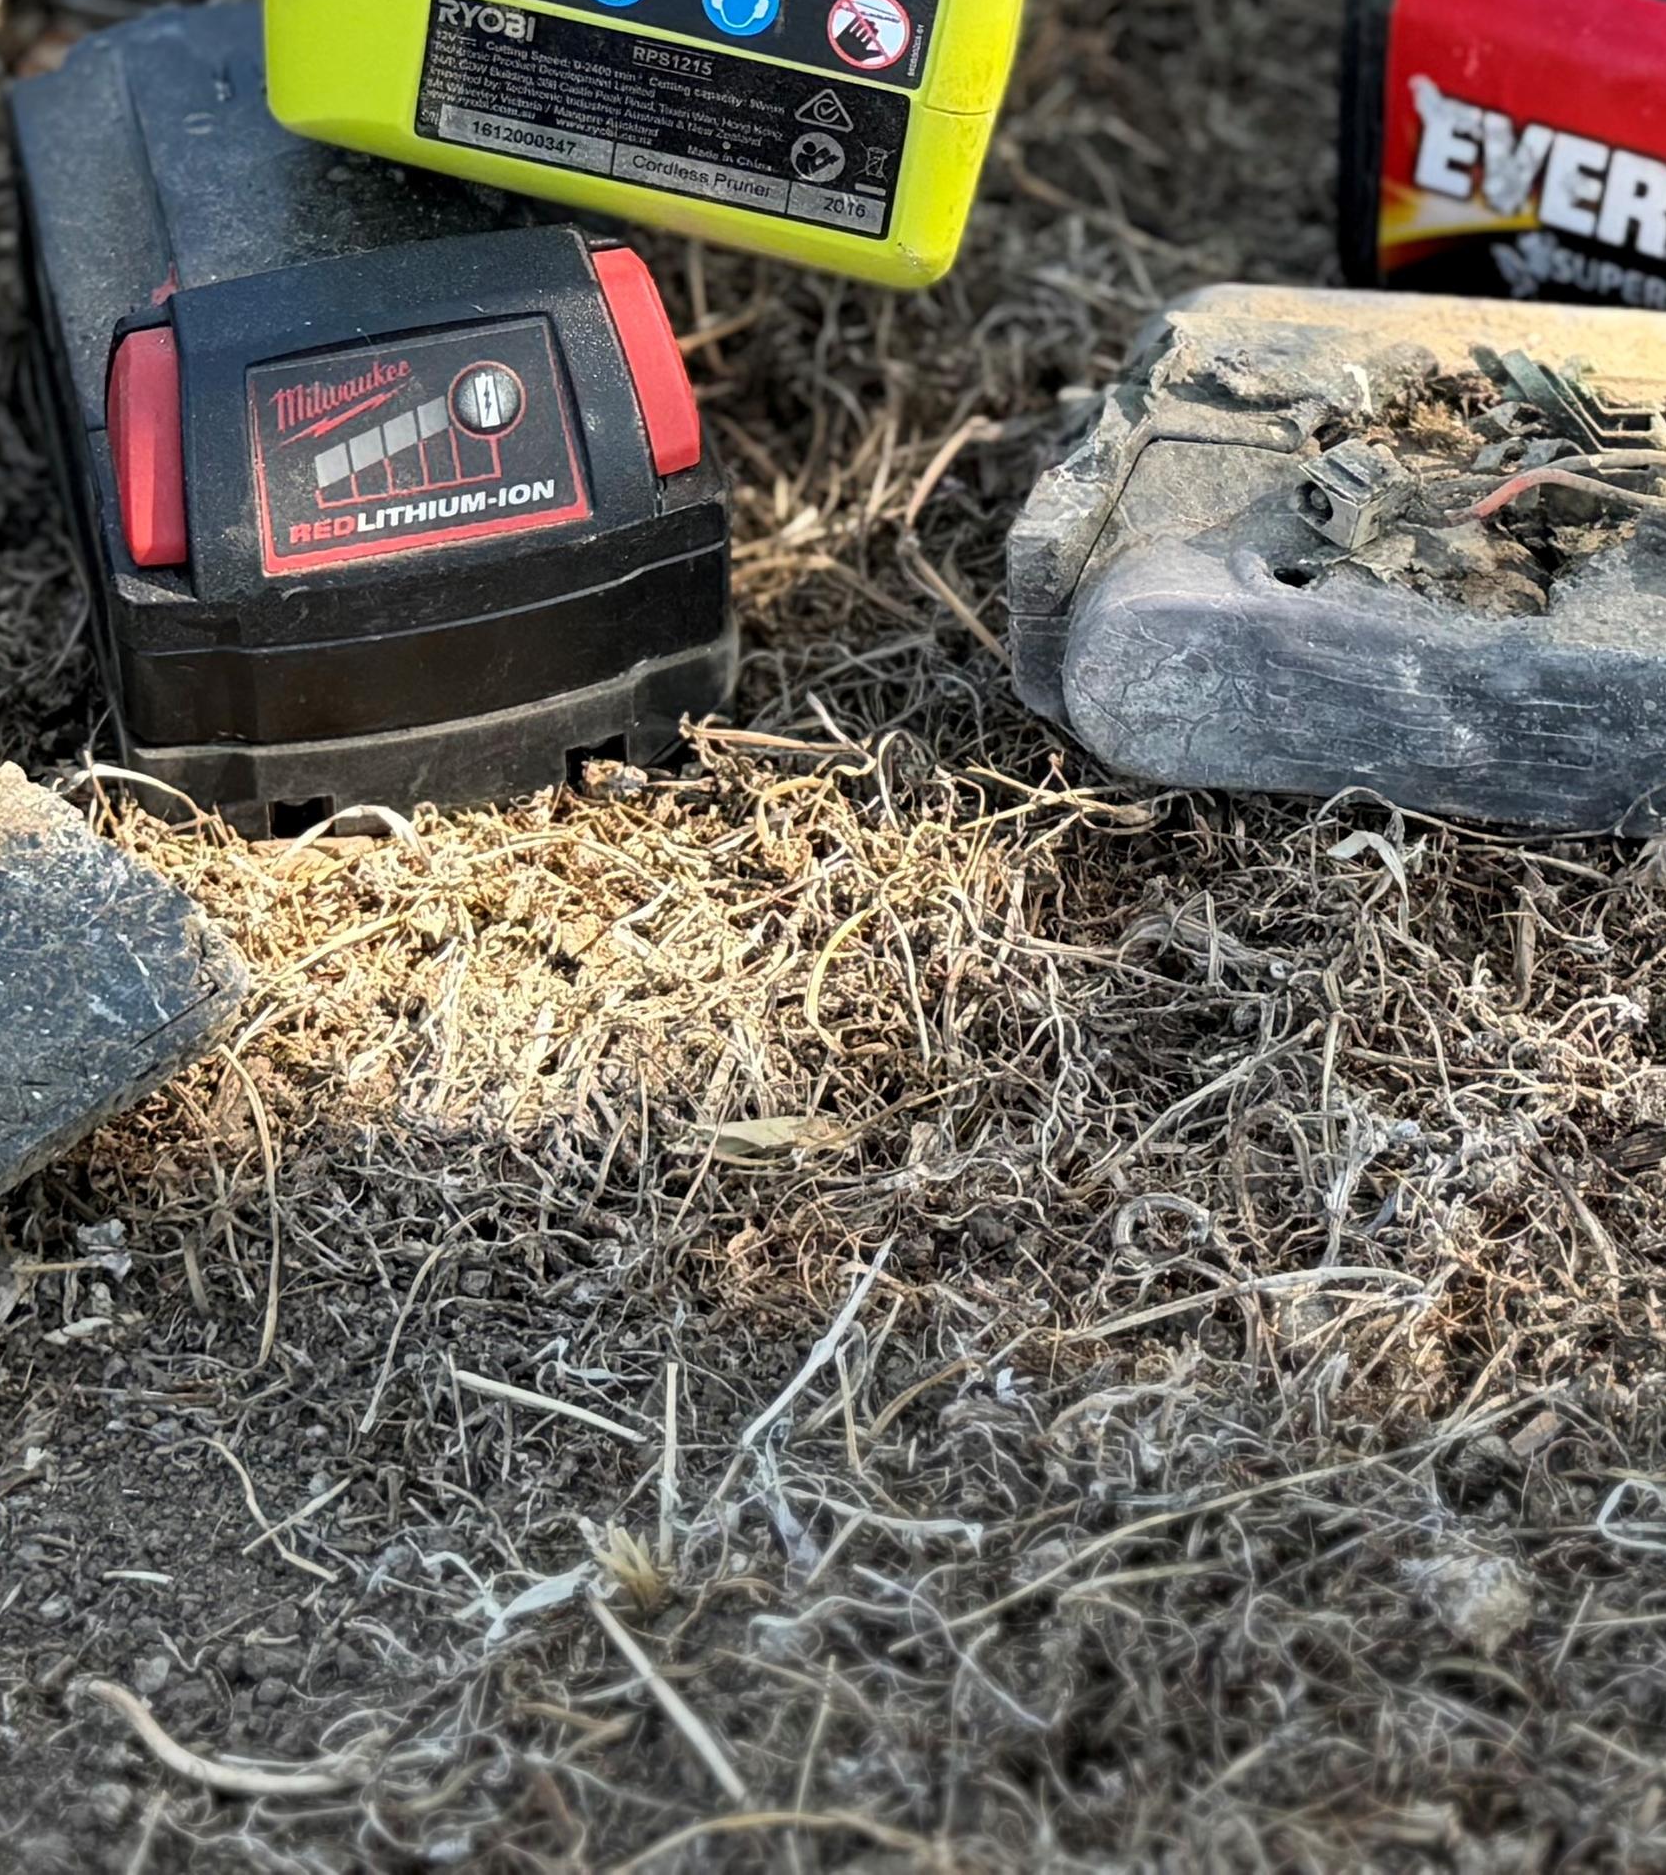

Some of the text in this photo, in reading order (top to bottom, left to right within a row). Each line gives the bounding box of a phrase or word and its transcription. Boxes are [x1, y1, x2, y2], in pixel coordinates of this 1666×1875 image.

[632, 46, 712, 75] RPS1215
[472, 120, 866, 218] 1612000347 Cordless Pruner 2016
[269, 360, 412, 432] Milwaukee
[288, 478, 556, 545] REDLITHIUM-ION
